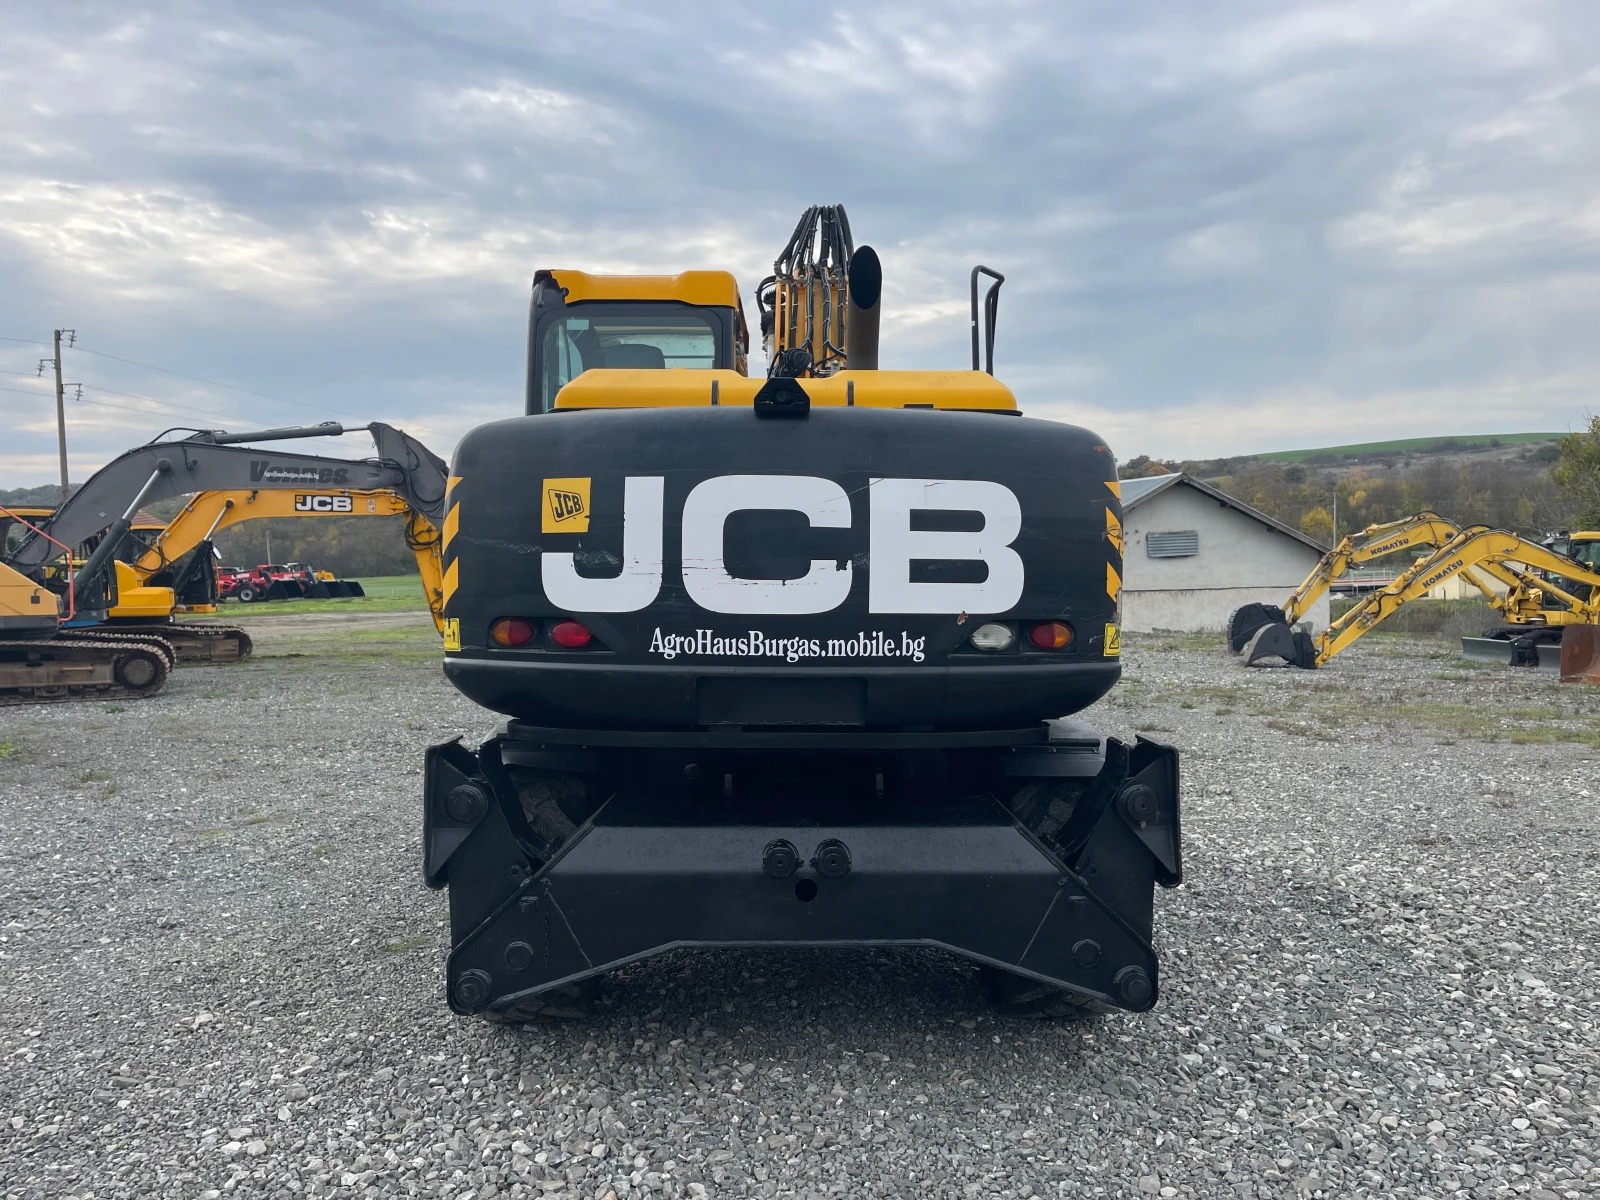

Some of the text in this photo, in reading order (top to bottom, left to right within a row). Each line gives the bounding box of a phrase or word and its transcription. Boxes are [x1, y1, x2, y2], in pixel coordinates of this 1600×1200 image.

[296, 495, 352, 512] JCB
[554, 492, 582, 519] JCB
[542, 475, 1025, 614] JCB
[1370, 538, 1410, 555] KOMATSU
[1422, 559, 1464, 588] KOMATSU
[649, 627, 926, 663] AgroHausBurgas.mobile.bg
